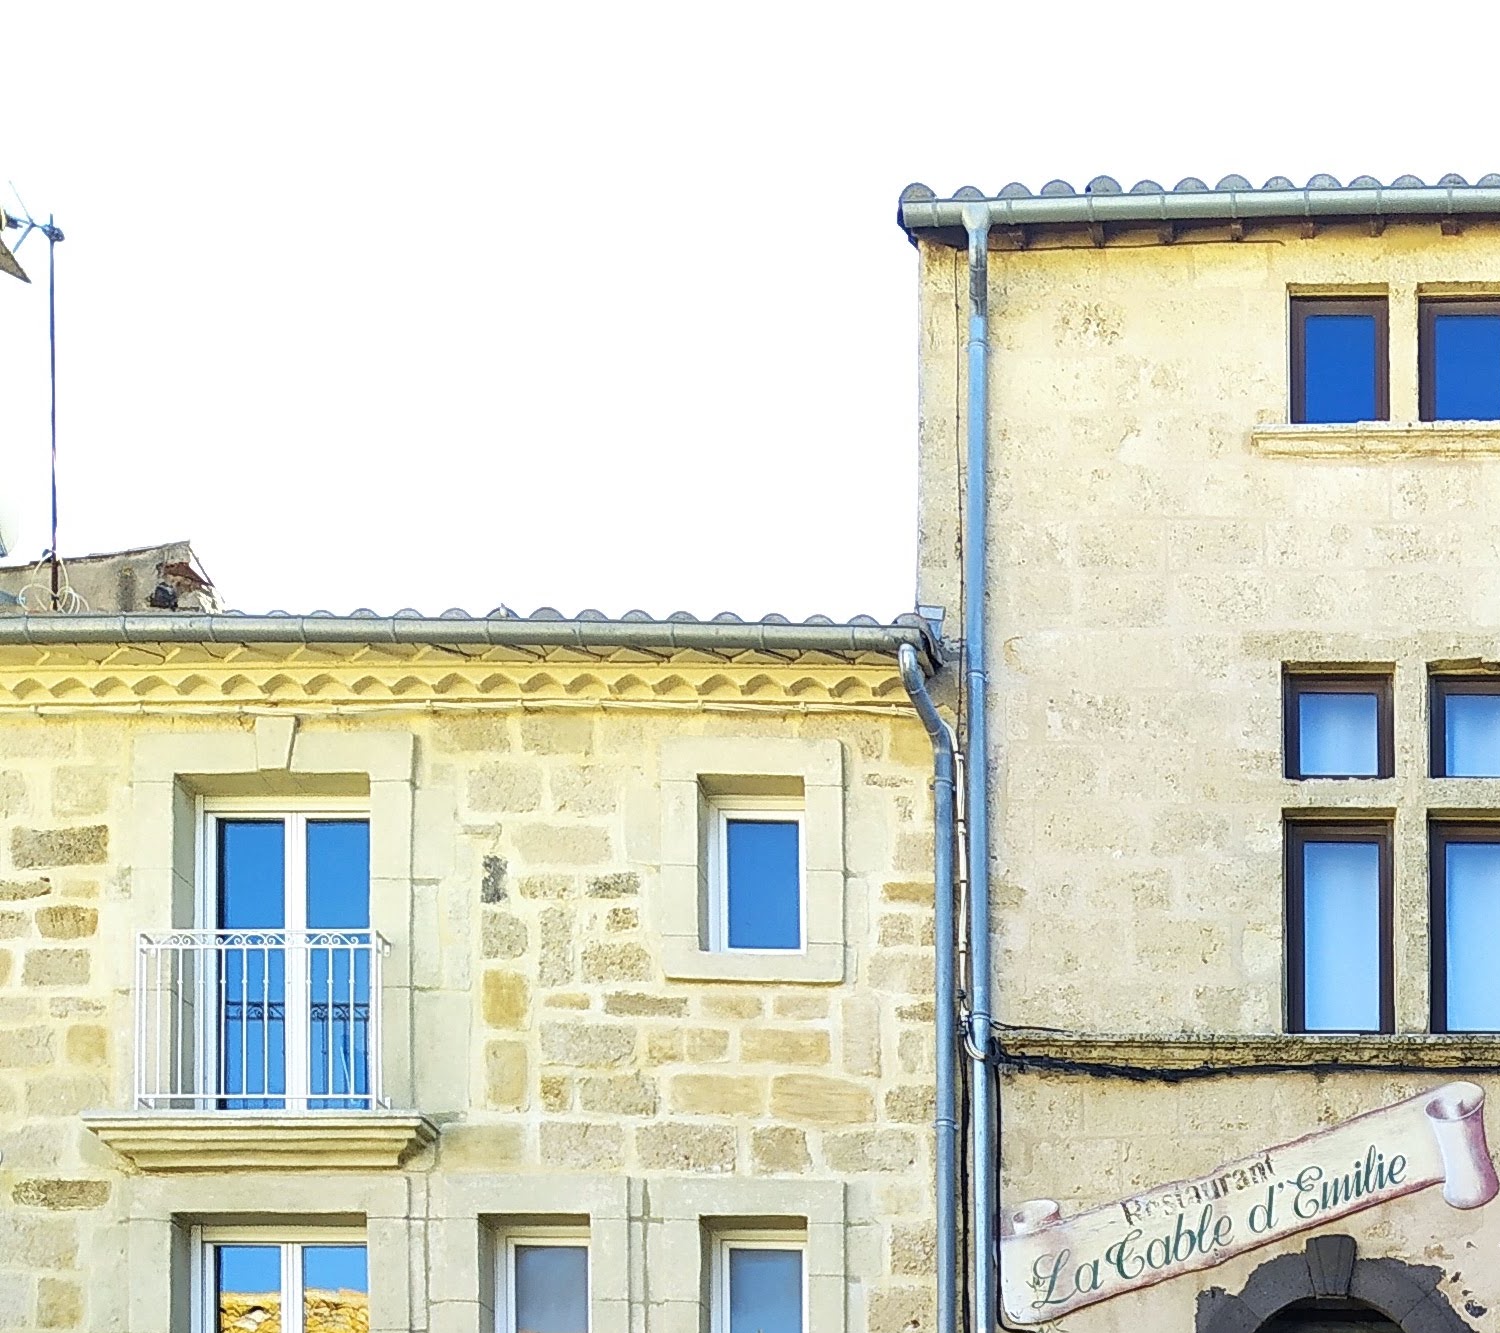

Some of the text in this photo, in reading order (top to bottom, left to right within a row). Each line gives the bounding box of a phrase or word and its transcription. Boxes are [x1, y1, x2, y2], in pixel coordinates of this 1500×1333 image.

[1120, 1153, 1275, 1226] Restaurant
[1031, 1249, 1104, 1309] La
[1105, 1204, 1234, 1280] Table
